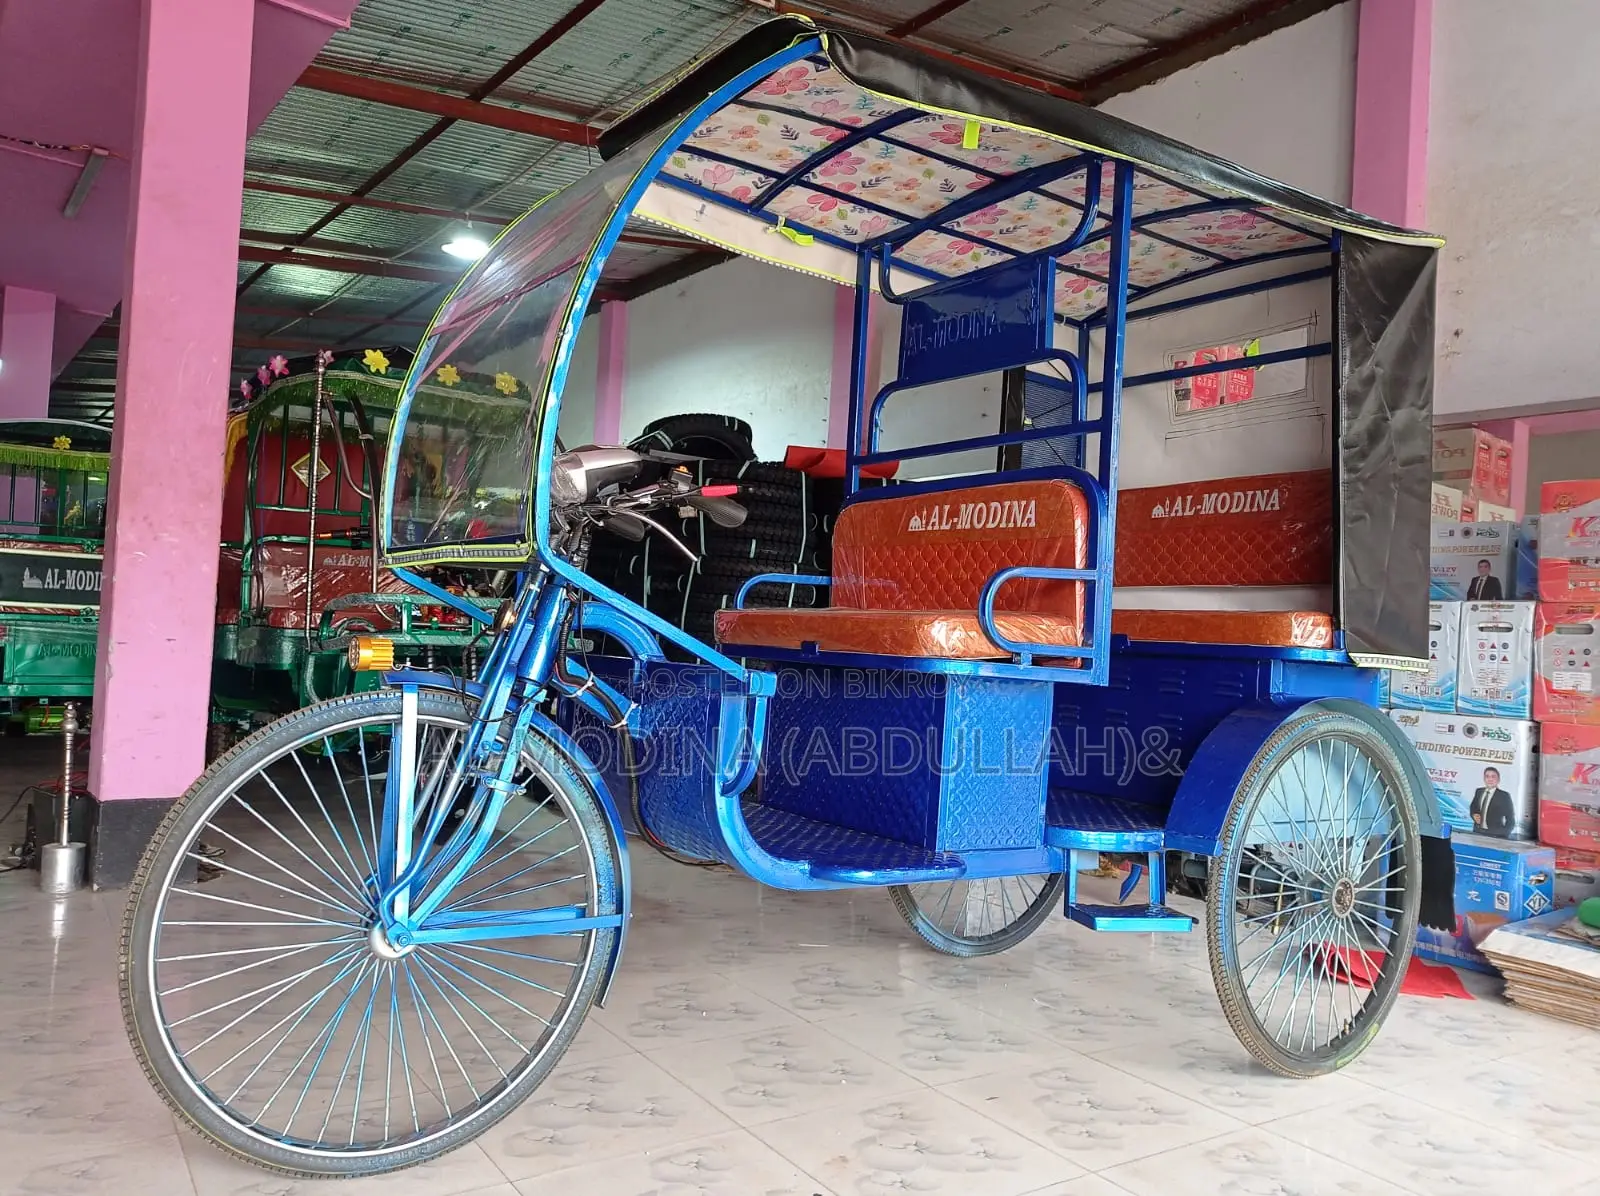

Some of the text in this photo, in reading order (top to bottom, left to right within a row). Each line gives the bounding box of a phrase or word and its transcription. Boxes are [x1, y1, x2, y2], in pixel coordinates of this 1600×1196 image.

[926, 500, 1037, 531] AL-MODINA
[1168, 488, 1281, 518] AL-MODINA
[1452, 745, 1488, 758] POWER
[1488, 750, 1515, 761] PLUS
